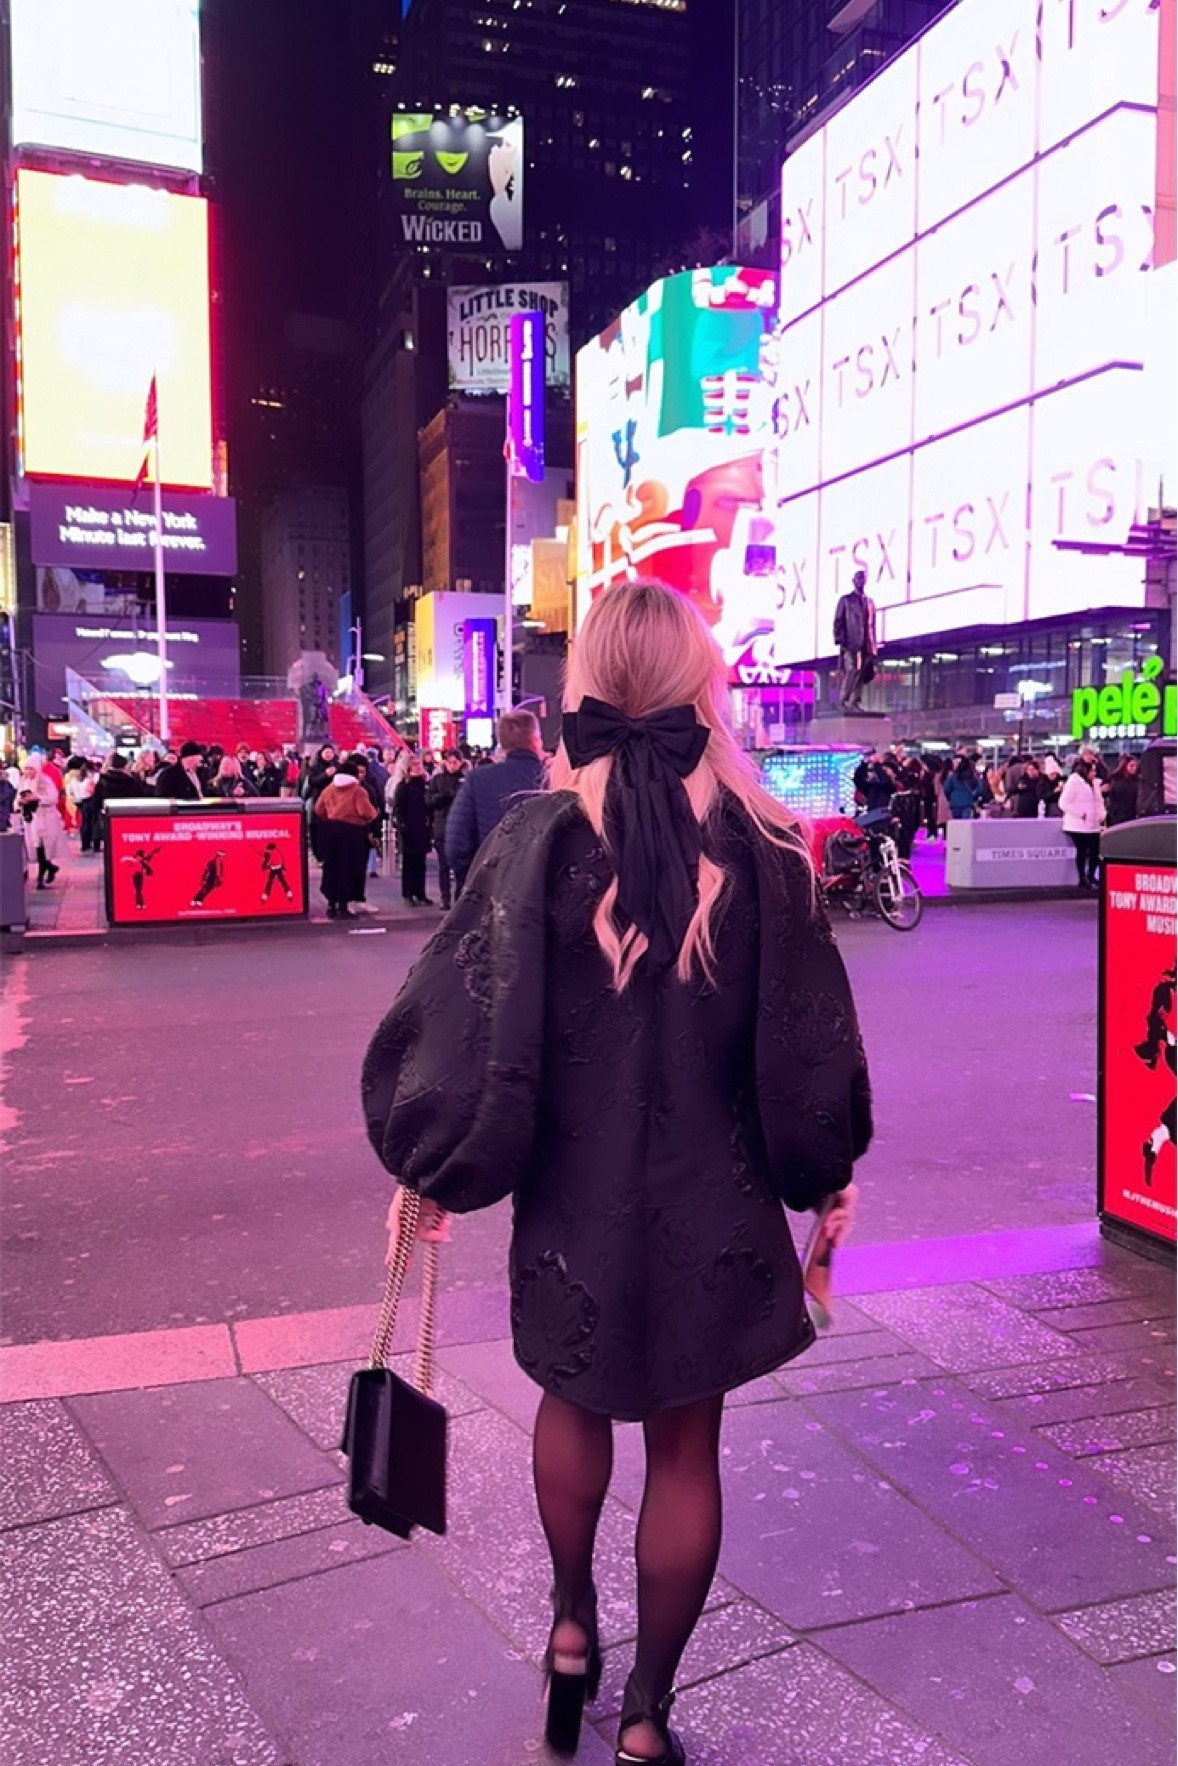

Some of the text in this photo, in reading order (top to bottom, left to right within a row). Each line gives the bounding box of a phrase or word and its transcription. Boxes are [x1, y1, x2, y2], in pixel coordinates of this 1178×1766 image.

[835, 124, 903, 220] TSX
[933, 29, 1020, 146] TSX
[405, 187, 480, 199] Brains. Heart.
[418, 201, 466, 214] Courage.
[460, 288, 559, 320] LITTLE SHOP
[832, 326, 901, 408] TSX
[930, 260, 1016, 359] TSX
[65, 505, 197, 530] Make a New York
[59, 525, 114, 545] Minute
[117, 528, 147, 547] last
[829, 528, 895, 593] TSX
[924, 491, 1010, 568] TSX
[1073, 655, 1163, 740] pelé
[122, 831, 151, 843] TONY
[246, 828, 291, 840] MUSICAL
[173, 820, 242, 832] BROADWAY'S
[991, 849, 1068, 860] TIMES SQUARE
[1110, 890, 1137, 911] TONY
